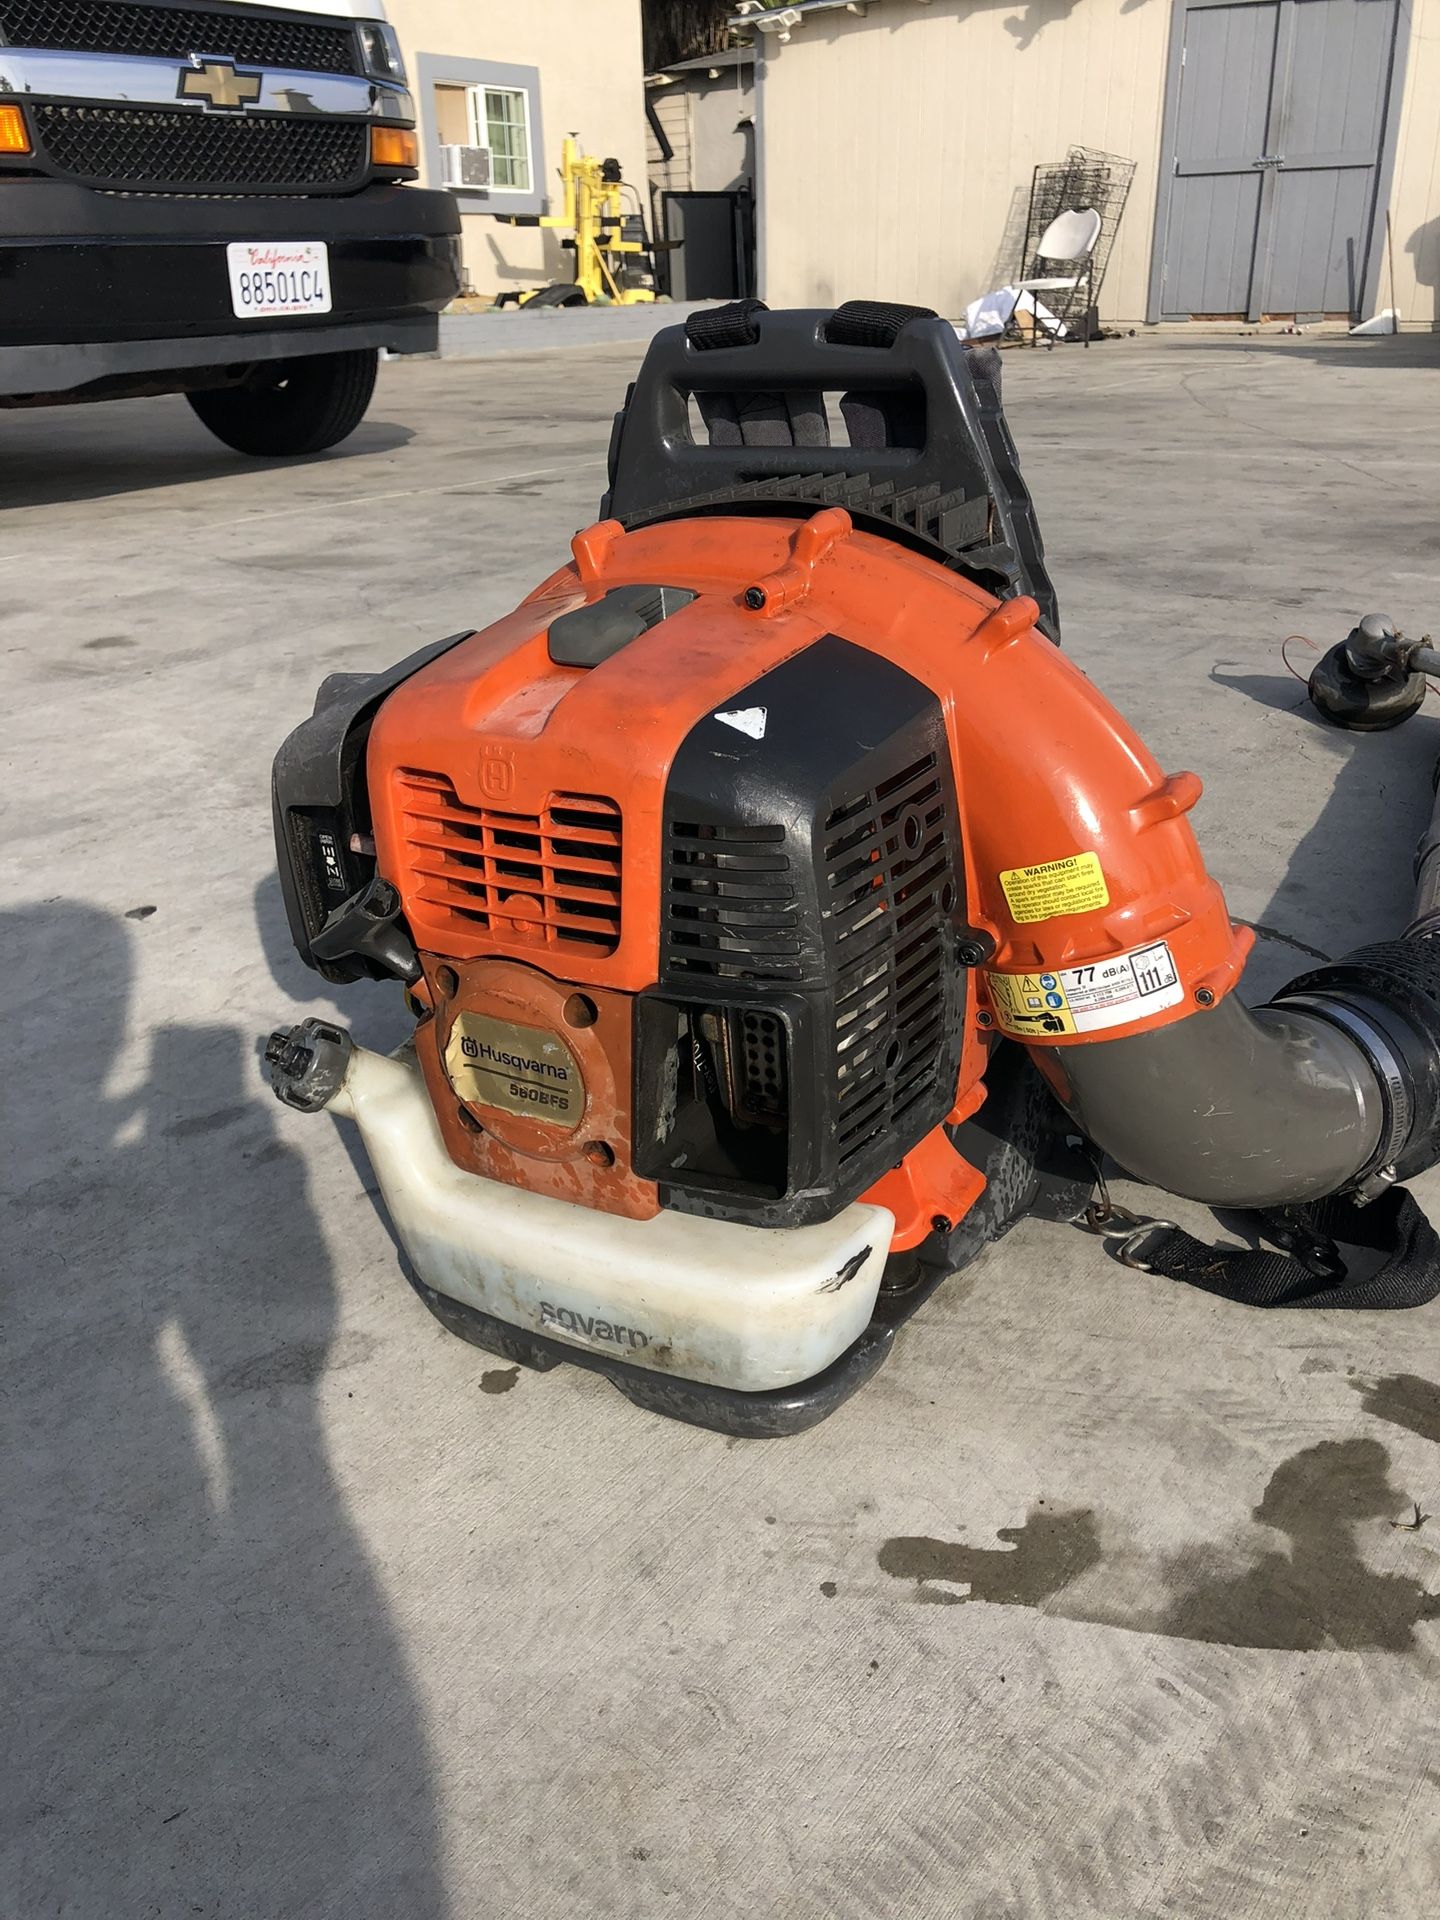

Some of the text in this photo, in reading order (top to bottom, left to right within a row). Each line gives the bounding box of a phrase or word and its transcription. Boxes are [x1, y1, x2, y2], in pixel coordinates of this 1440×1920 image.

[248, 248, 310, 269] California
[240, 271, 323, 305] 88501C4
[1004, 877, 1029, 886] Operation
[1048, 866, 1079, 878] equipment
[1024, 858, 1077, 876] WARNING!
[1008, 890, 1025, 898] around
[1022, 880, 1040, 889] sparks
[1041, 895, 1059, 904] should
[1060, 891, 1079, 900] contact
[1072, 966, 1097, 985] 77
[1101, 963, 1129, 978] dB(A)
[1139, 967, 1161, 990] 111
[480, 1043, 568, 1080] Husqvarna
